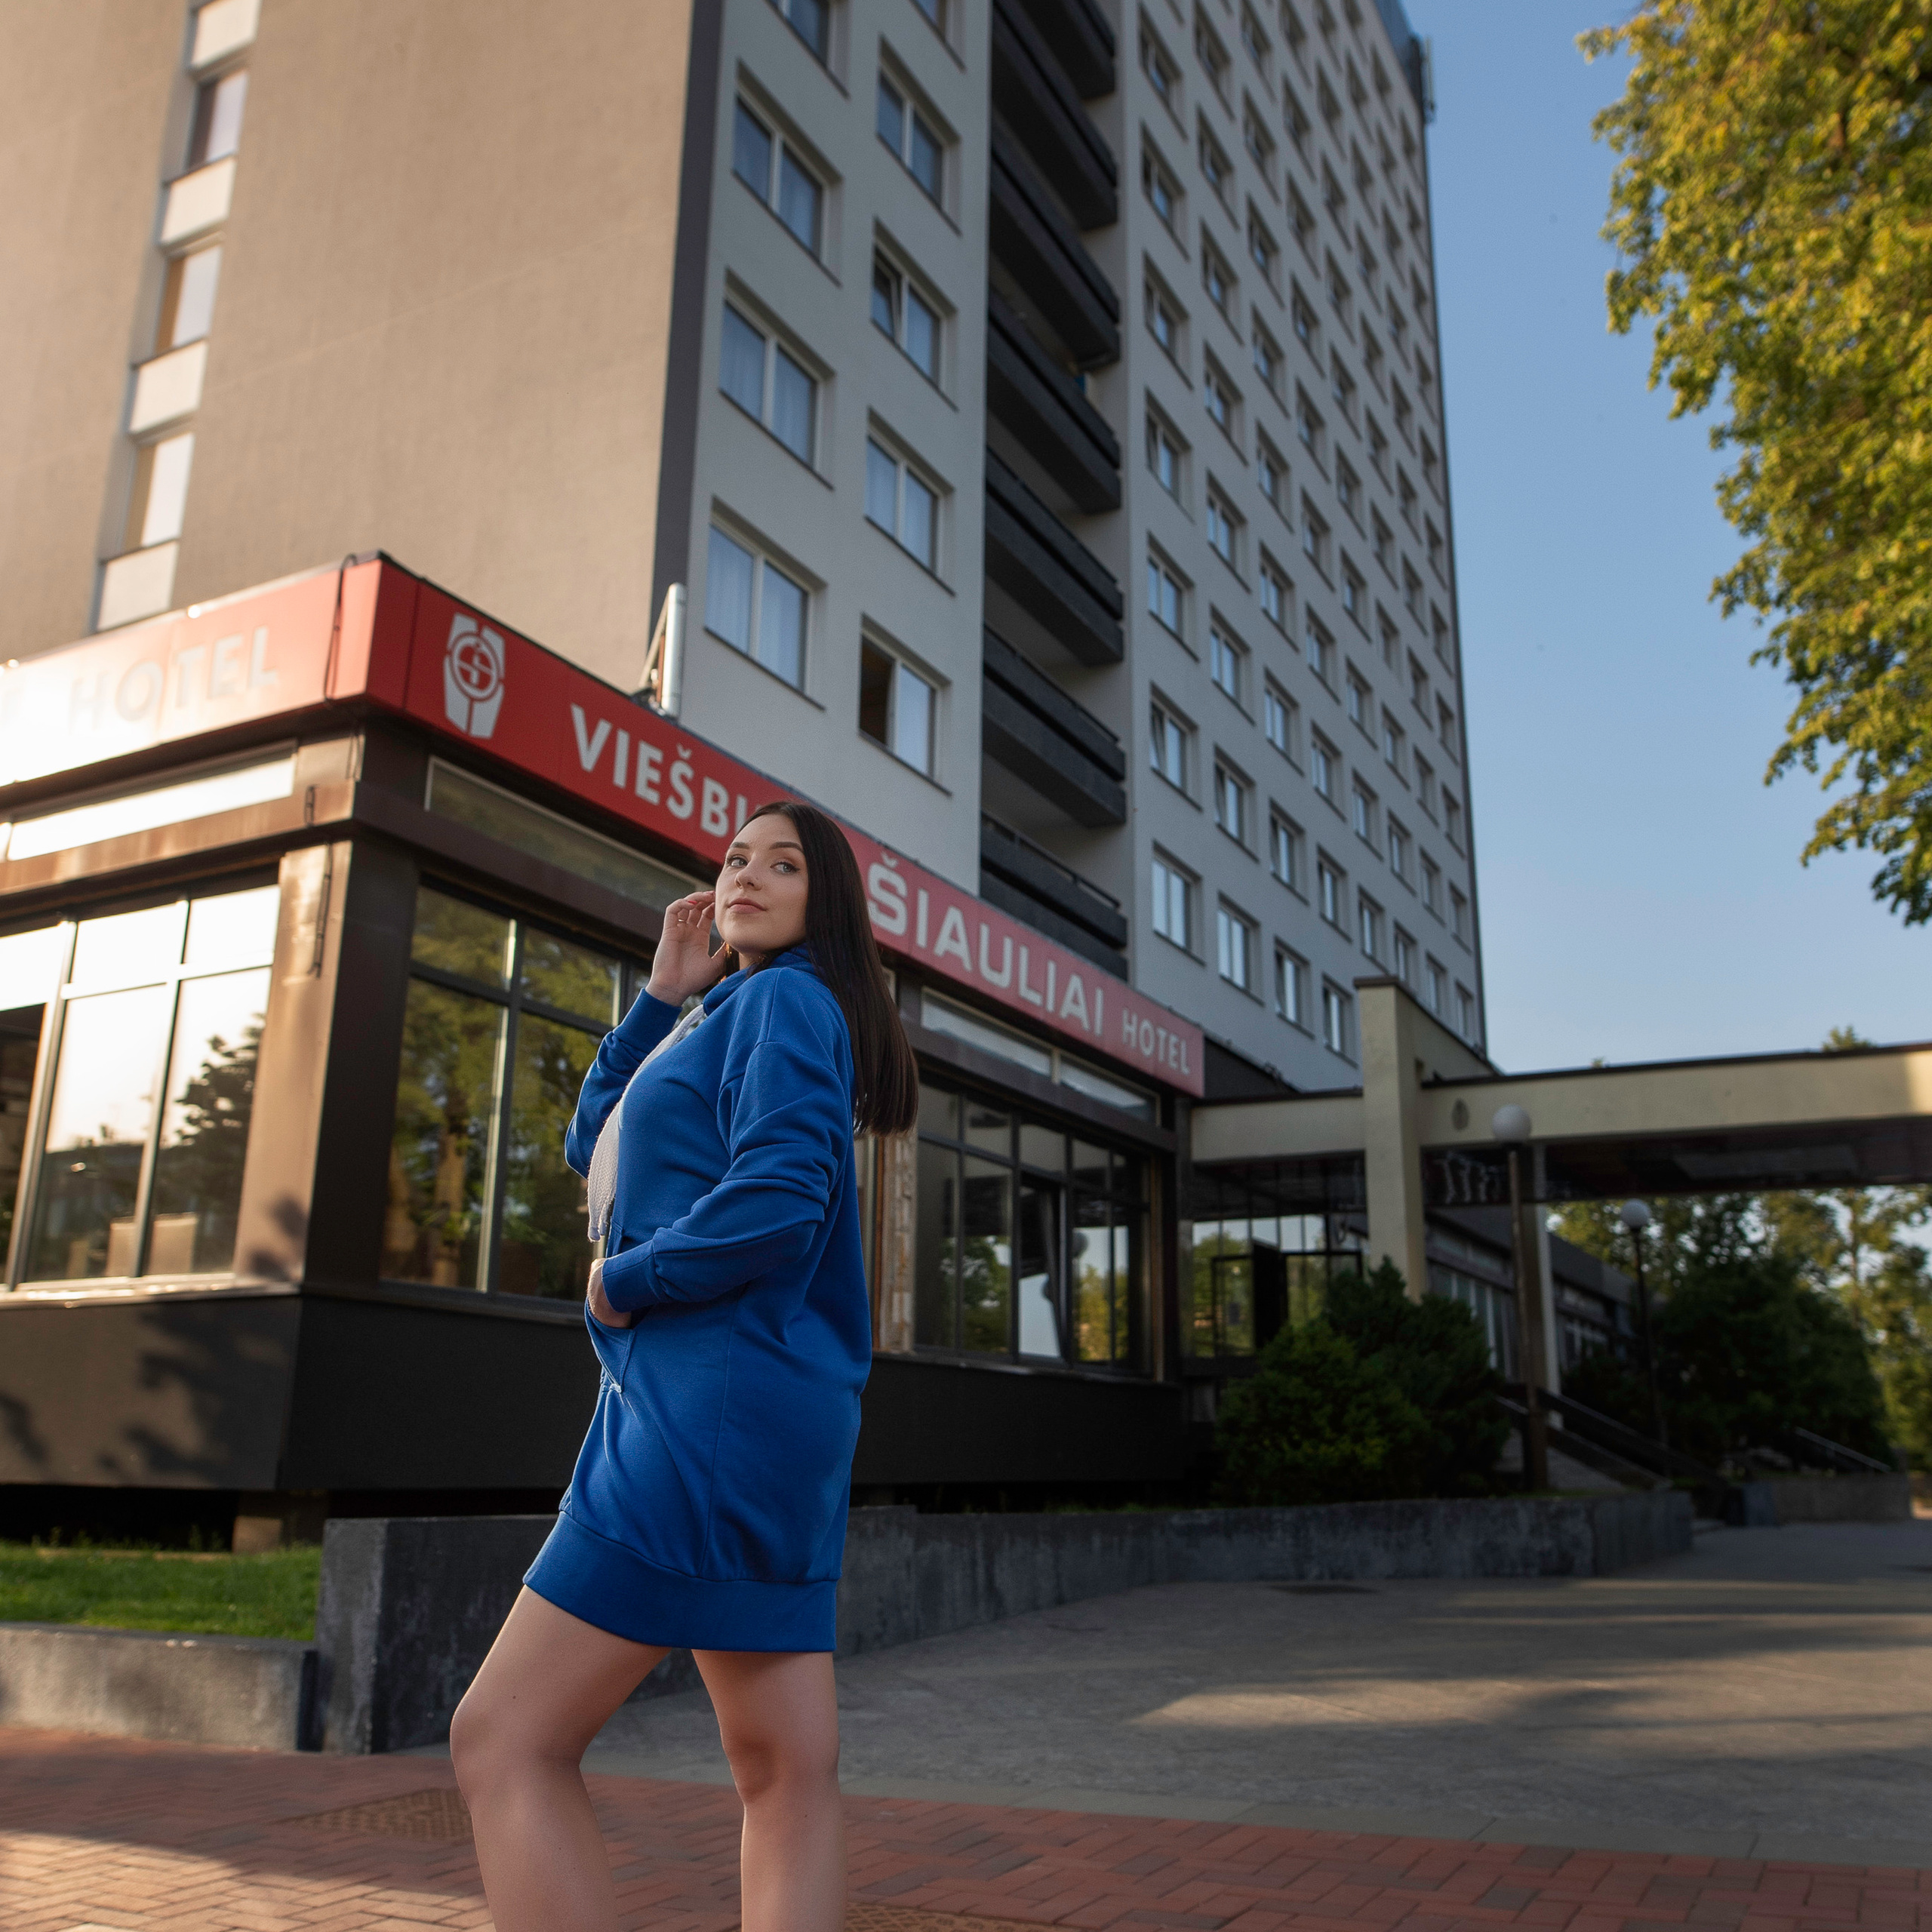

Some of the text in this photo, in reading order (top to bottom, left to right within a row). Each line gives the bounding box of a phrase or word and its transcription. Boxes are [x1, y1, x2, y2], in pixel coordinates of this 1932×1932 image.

[68, 626, 279, 732] HOTEL
[868, 851, 1104, 1036] ŠIAULIAI
[1121, 1008, 1191, 1076] HOTEL
